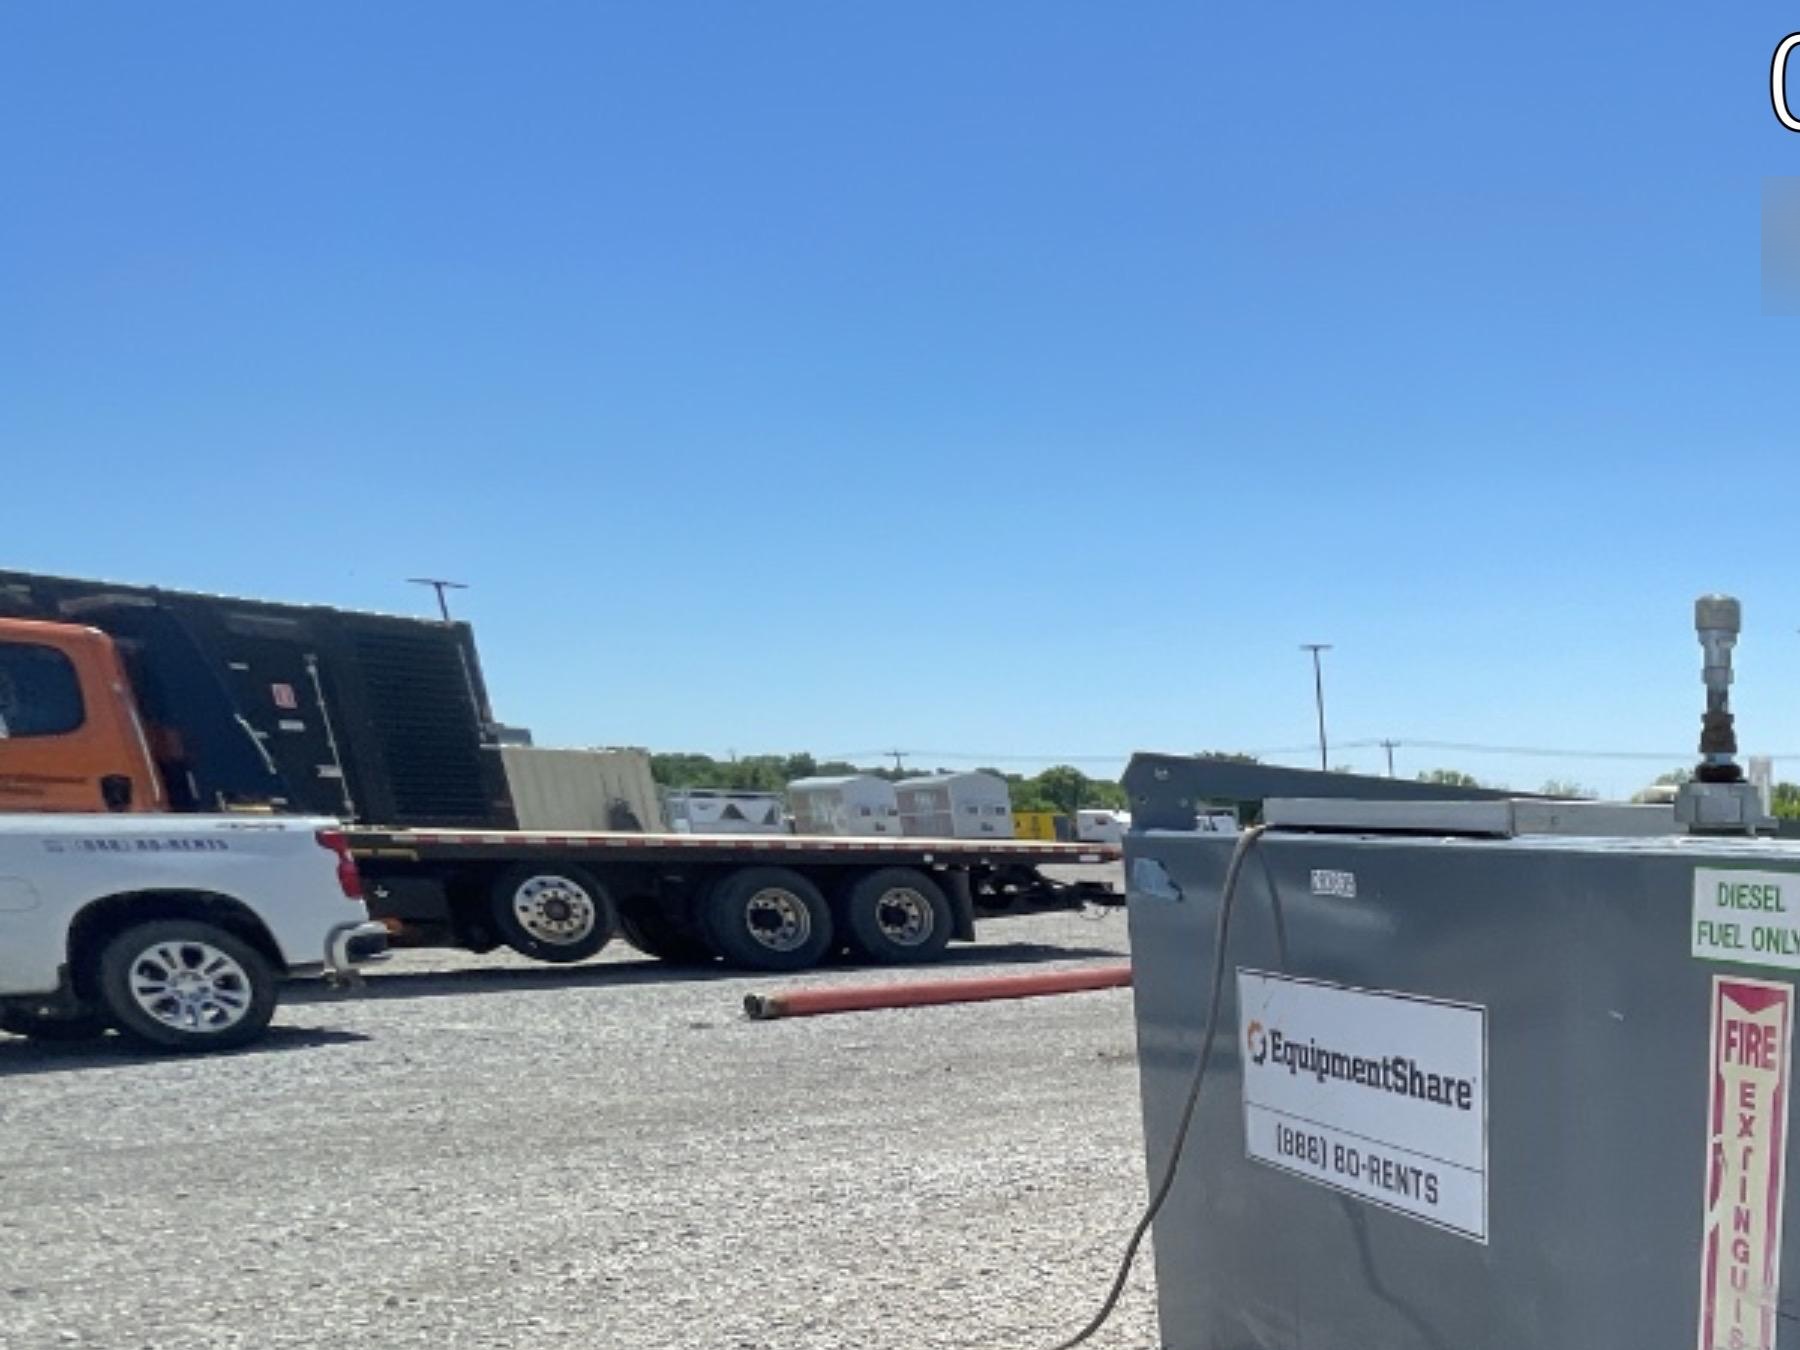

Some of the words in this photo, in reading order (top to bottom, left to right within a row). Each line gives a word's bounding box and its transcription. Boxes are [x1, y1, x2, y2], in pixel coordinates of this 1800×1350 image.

[1717, 881, 1786, 912] DIESEL
[1697, 920, 1744, 948] FUEL
[1269, 1029, 1472, 1110] EquipmentShare
[1724, 1019, 1777, 1071] FIRE
[1276, 1123, 1328, 1171] (888)
[1333, 1143, 1439, 1205] 80-RENTS
